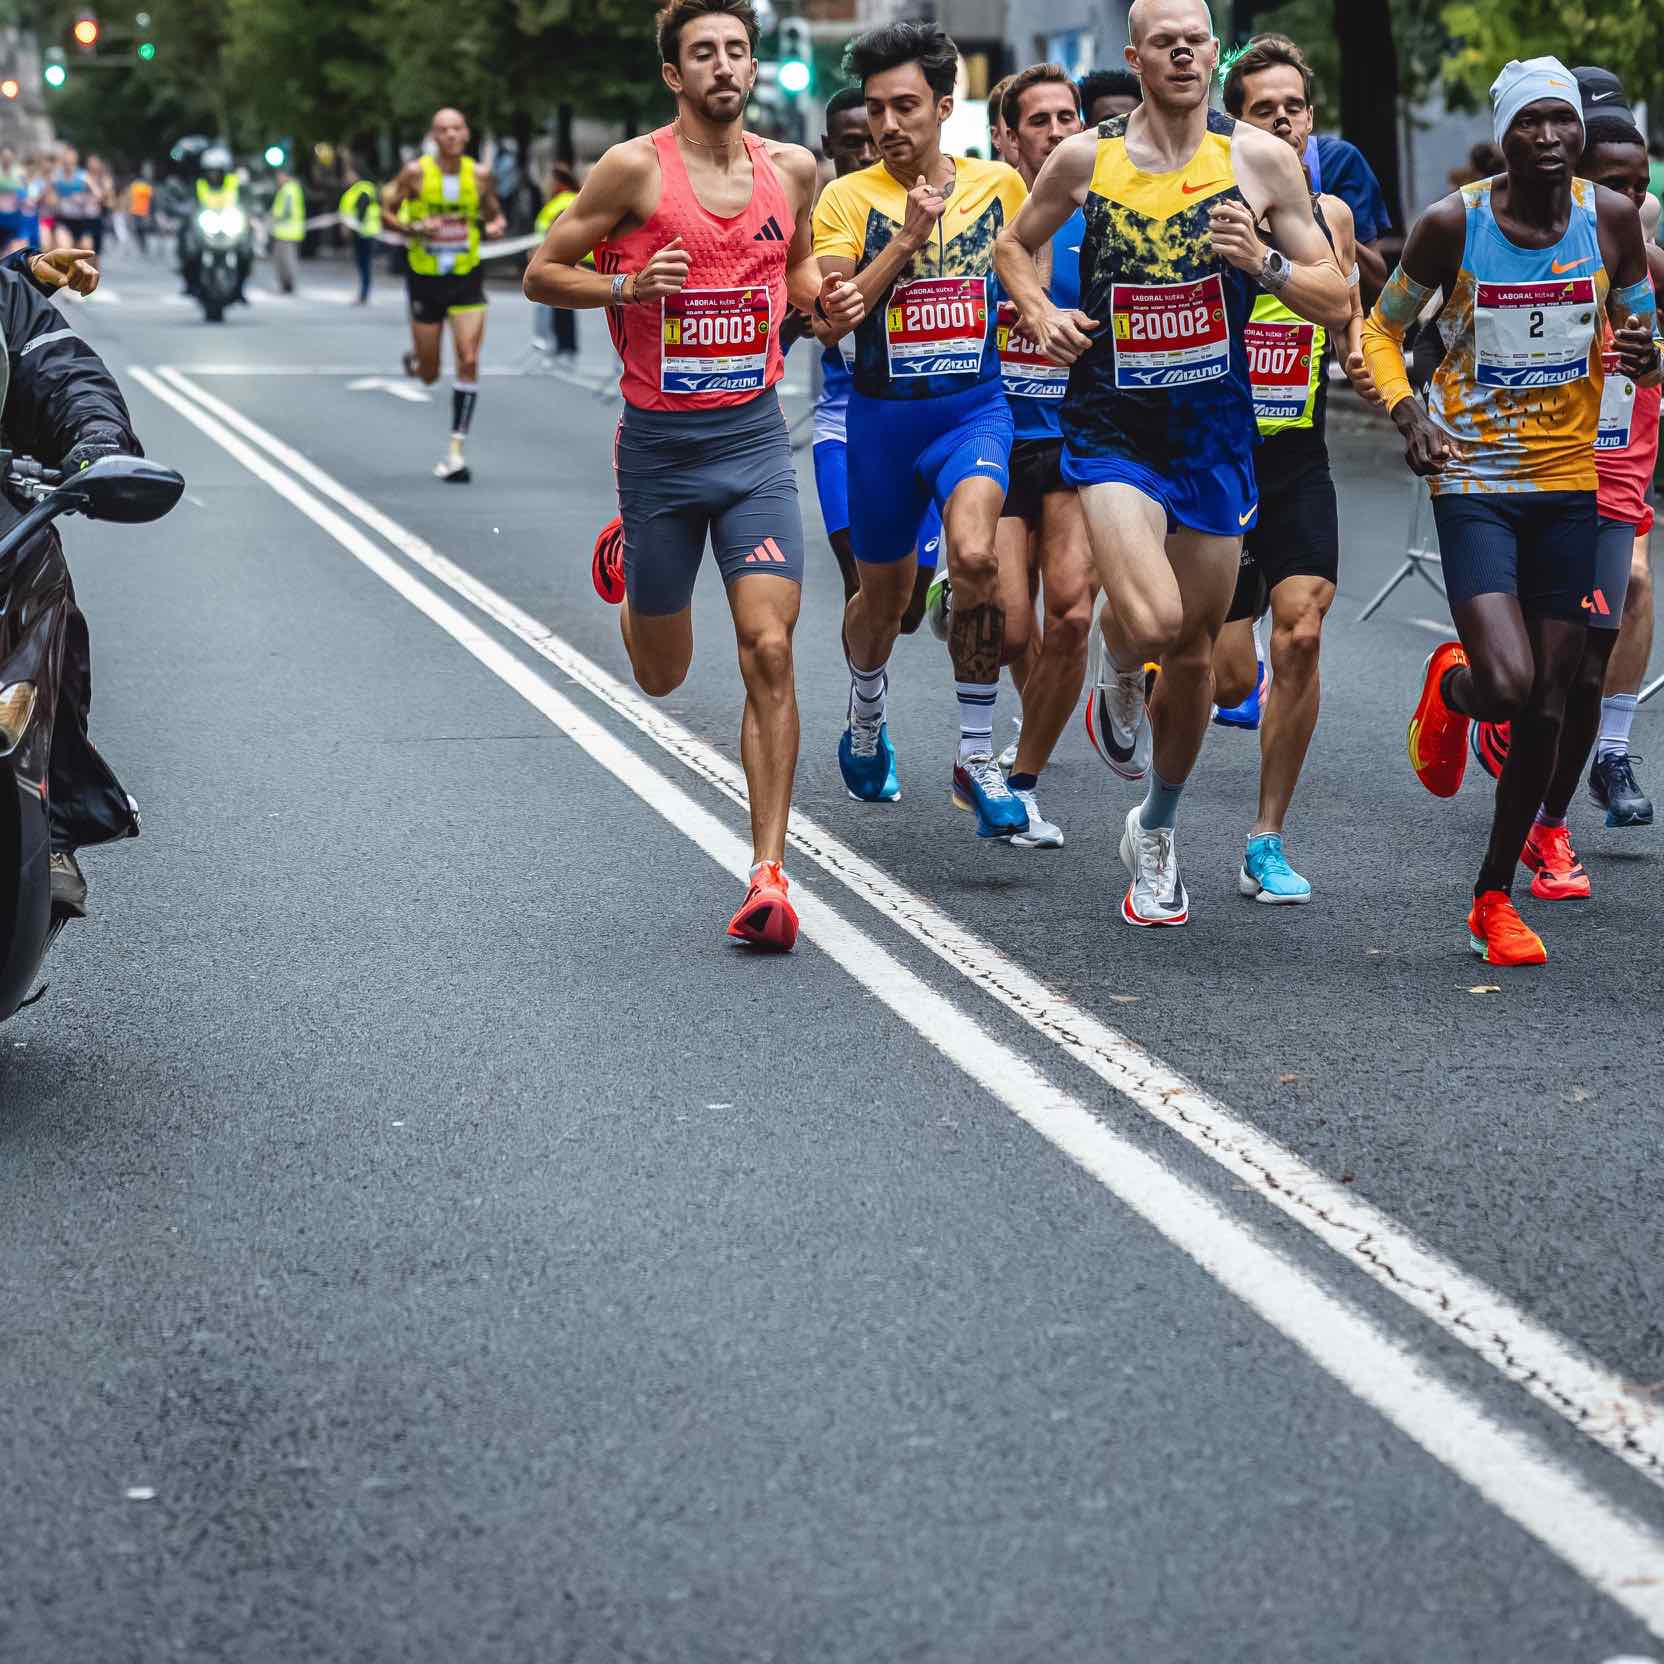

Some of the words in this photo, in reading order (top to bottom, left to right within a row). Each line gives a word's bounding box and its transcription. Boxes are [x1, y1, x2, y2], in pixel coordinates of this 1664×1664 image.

[685, 299, 717, 307] LABORAL
[1497, 292, 1533, 300] LABORAL
[906, 302, 975, 331] 20001
[1130, 307, 1211, 340] 20002
[1529, 310, 1544, 338] 2
[682, 315, 756, 346] 20003
[930, 358, 977, 372] MIZUN
[1246, 346, 1300, 374] 0007
[704, 376, 758, 389] MIZUNO
[1161, 363, 1222, 384] MIZUNO
[1520, 367, 1580, 385] MIZUNO
[1023, 382, 1066, 395] MIZUN
